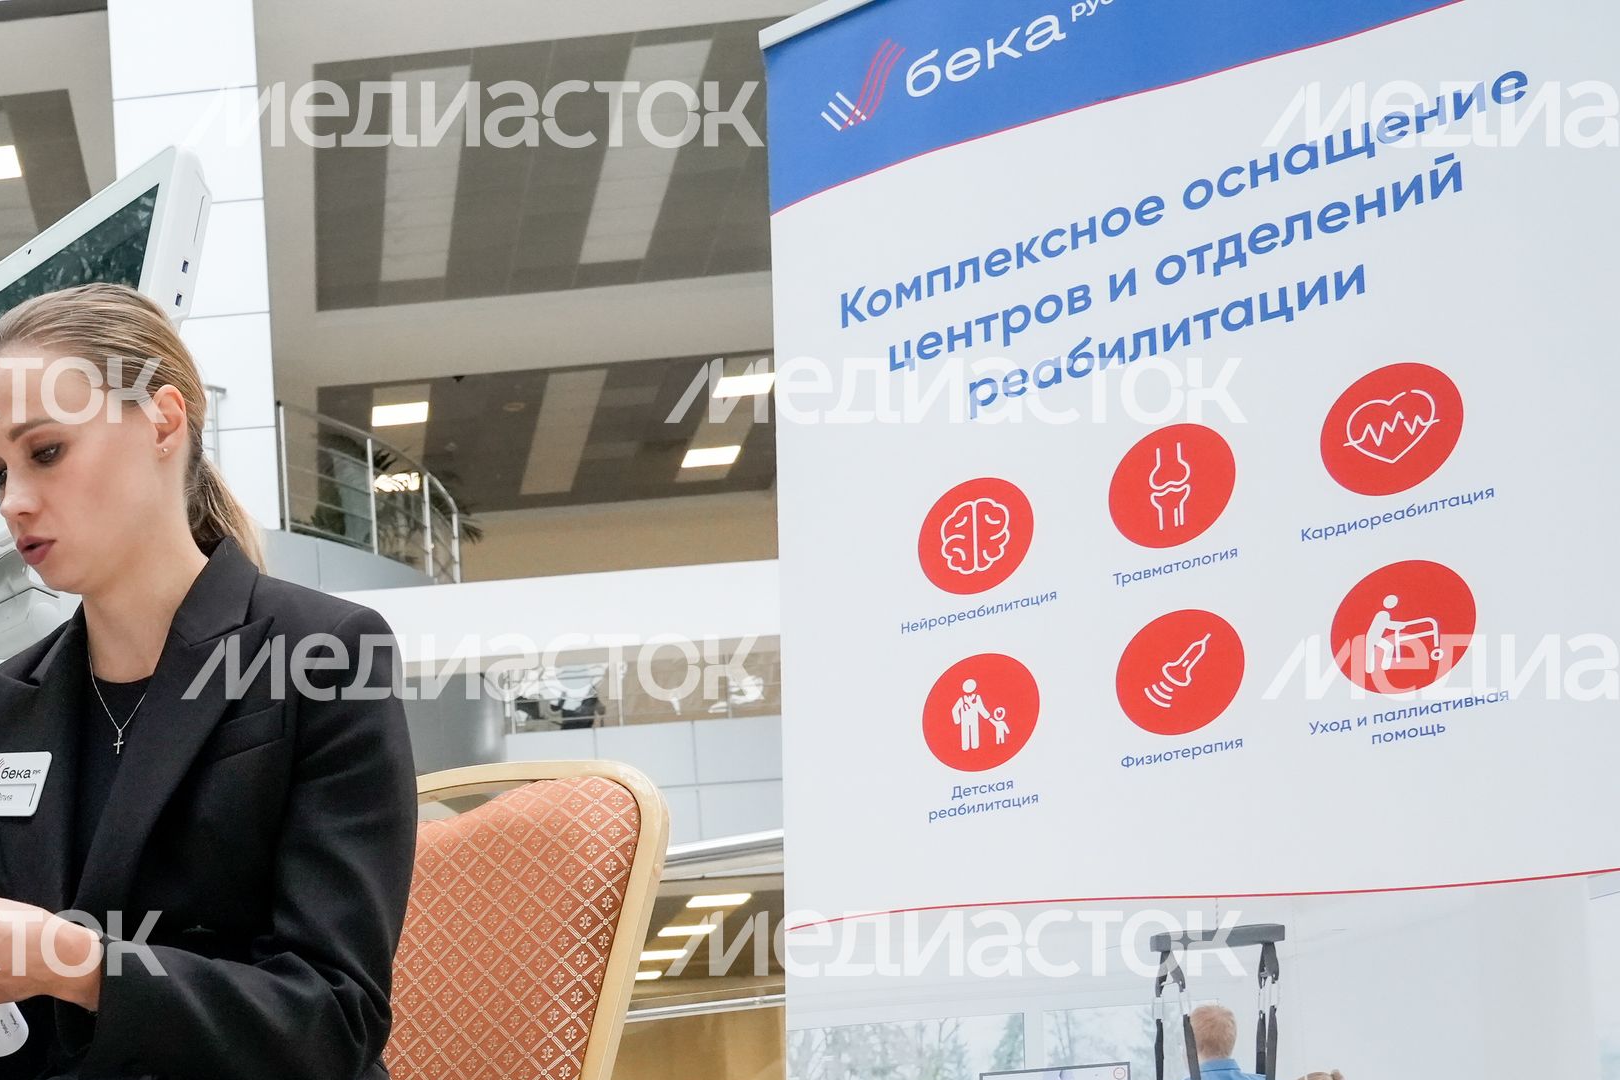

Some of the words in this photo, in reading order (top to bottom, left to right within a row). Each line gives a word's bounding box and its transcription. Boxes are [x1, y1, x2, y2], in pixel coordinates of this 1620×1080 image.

[904, 13, 1067, 99] бека
[839, 194, 1166, 330] Комплексное
[1182, 69, 1528, 213] оснащение
[888, 284, 1093, 373] центров
[1108, 267, 1138, 304] и
[1155, 152, 1464, 287] отделений
[967, 262, 1367, 420] реабилитации
[1299, 487, 1496, 542] Кардиореабилтация
[1113, 546, 1240, 588] Травматология
[900, 591, 1058, 635] Нейрореабилитация
[1308, 719, 1352, 736] Уход
[1356, 716, 1368, 728] и
[1372, 689, 1510, 725] паллиативная
[1371, 723, 1446, 745] помощь
[0, 767, 32, 780] бека
[1121, 736, 1245, 770] Физиотерапия
[928, 792, 1040, 823] реабилитация
[951, 777, 1015, 801] Детская
